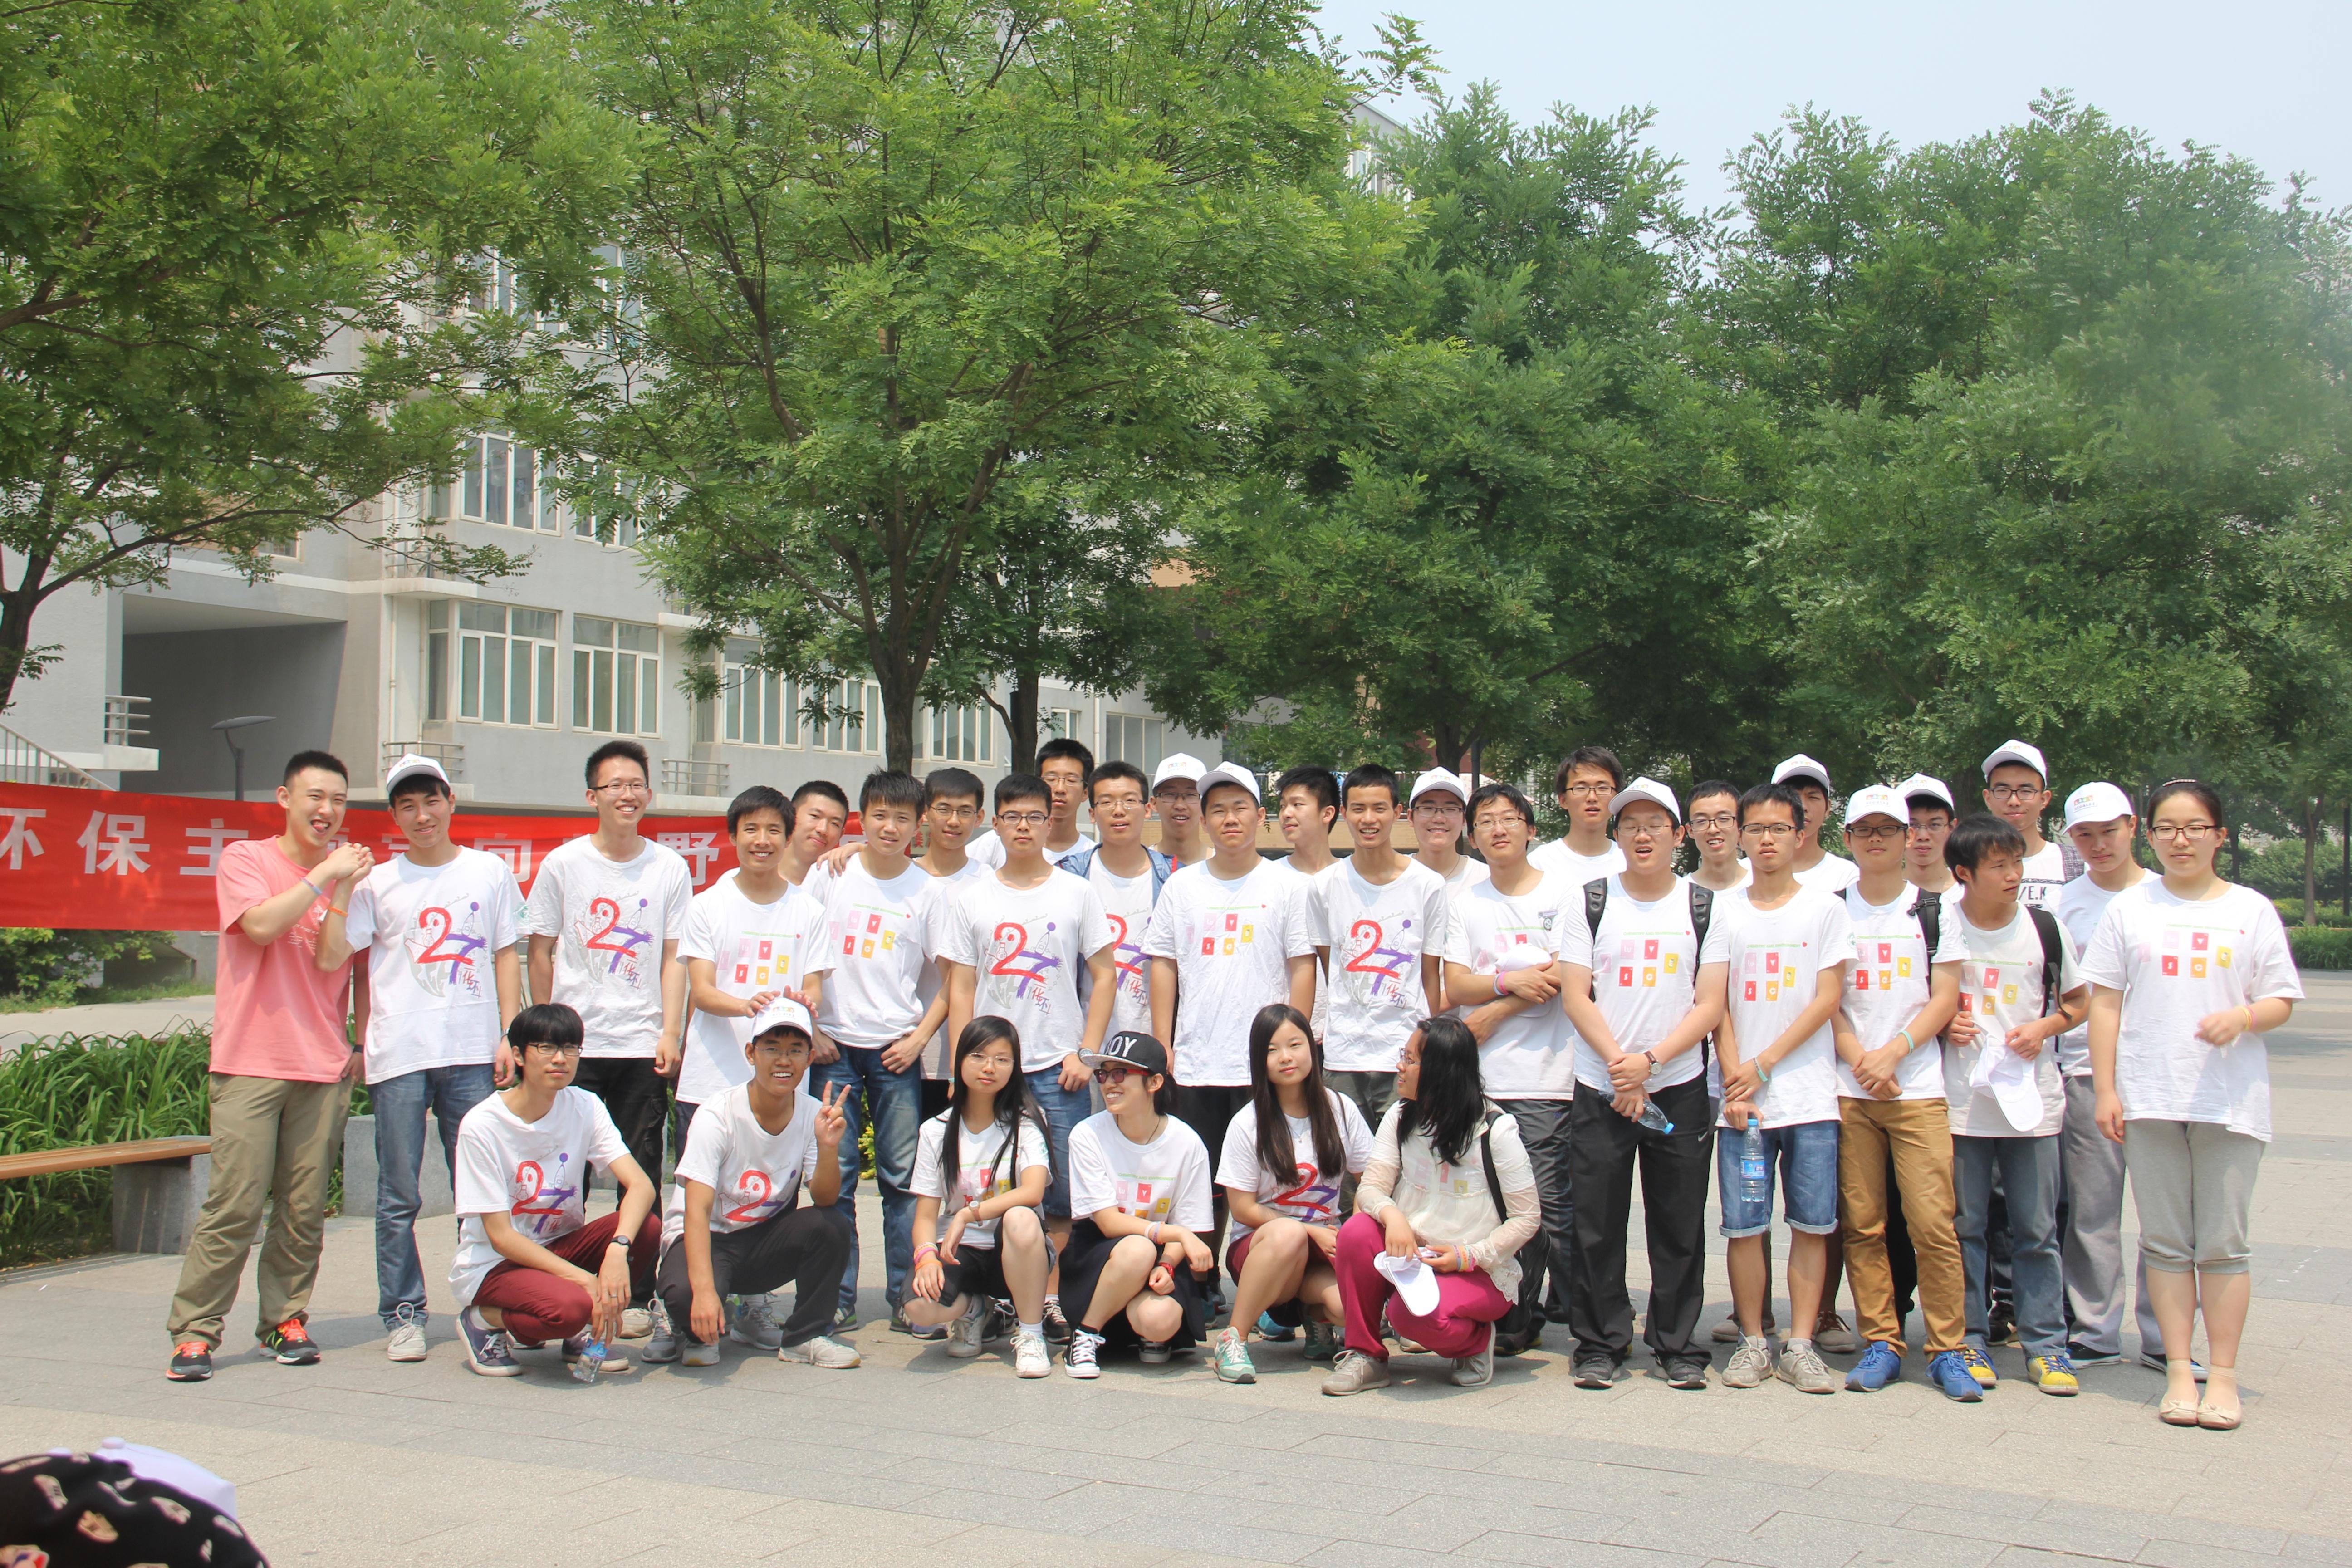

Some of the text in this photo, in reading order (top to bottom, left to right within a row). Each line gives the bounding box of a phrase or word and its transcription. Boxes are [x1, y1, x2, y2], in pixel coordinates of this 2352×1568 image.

[417, 907, 488, 985] 27
[587, 897, 654, 974] 27
[990, 922, 1063, 998] 27
[1345, 920, 1415, 996] 27
[1105, 1036, 1137, 1057] OY
[512, 1161, 577, 1235] 27
